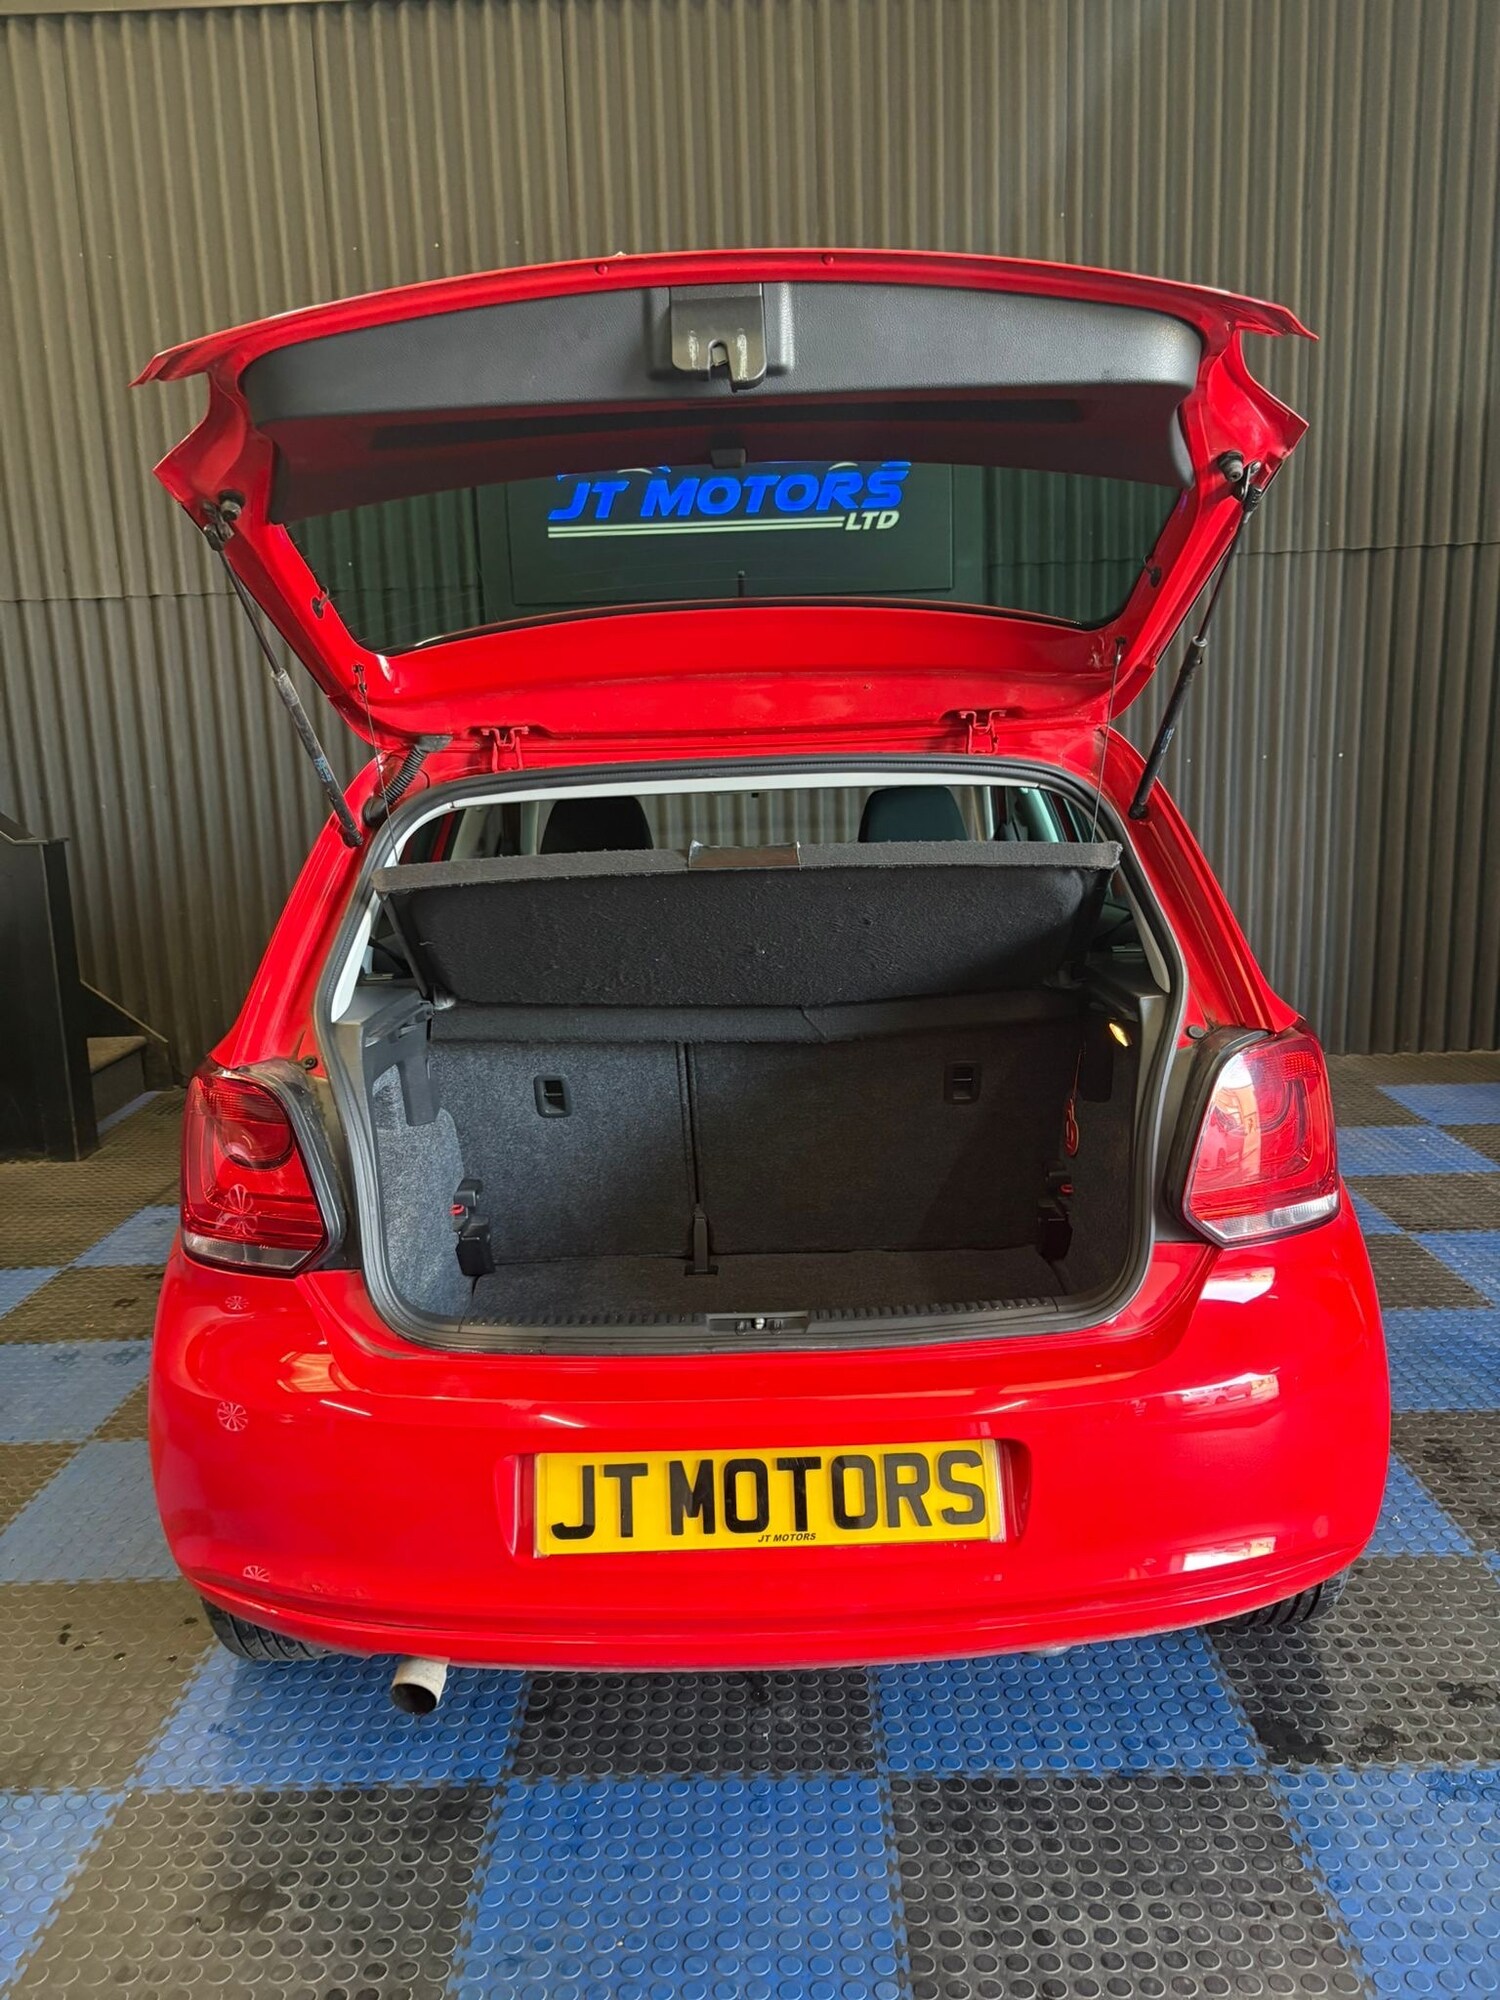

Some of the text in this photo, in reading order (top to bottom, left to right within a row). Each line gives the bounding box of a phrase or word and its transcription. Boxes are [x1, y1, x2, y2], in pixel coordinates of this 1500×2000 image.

[548, 470, 909, 520] JT MOTORS
[845, 510, 900, 531] LTD
[550, 1450, 987, 1540] JT MOTORS
[758, 1532, 816, 1543] JT MOTORS
